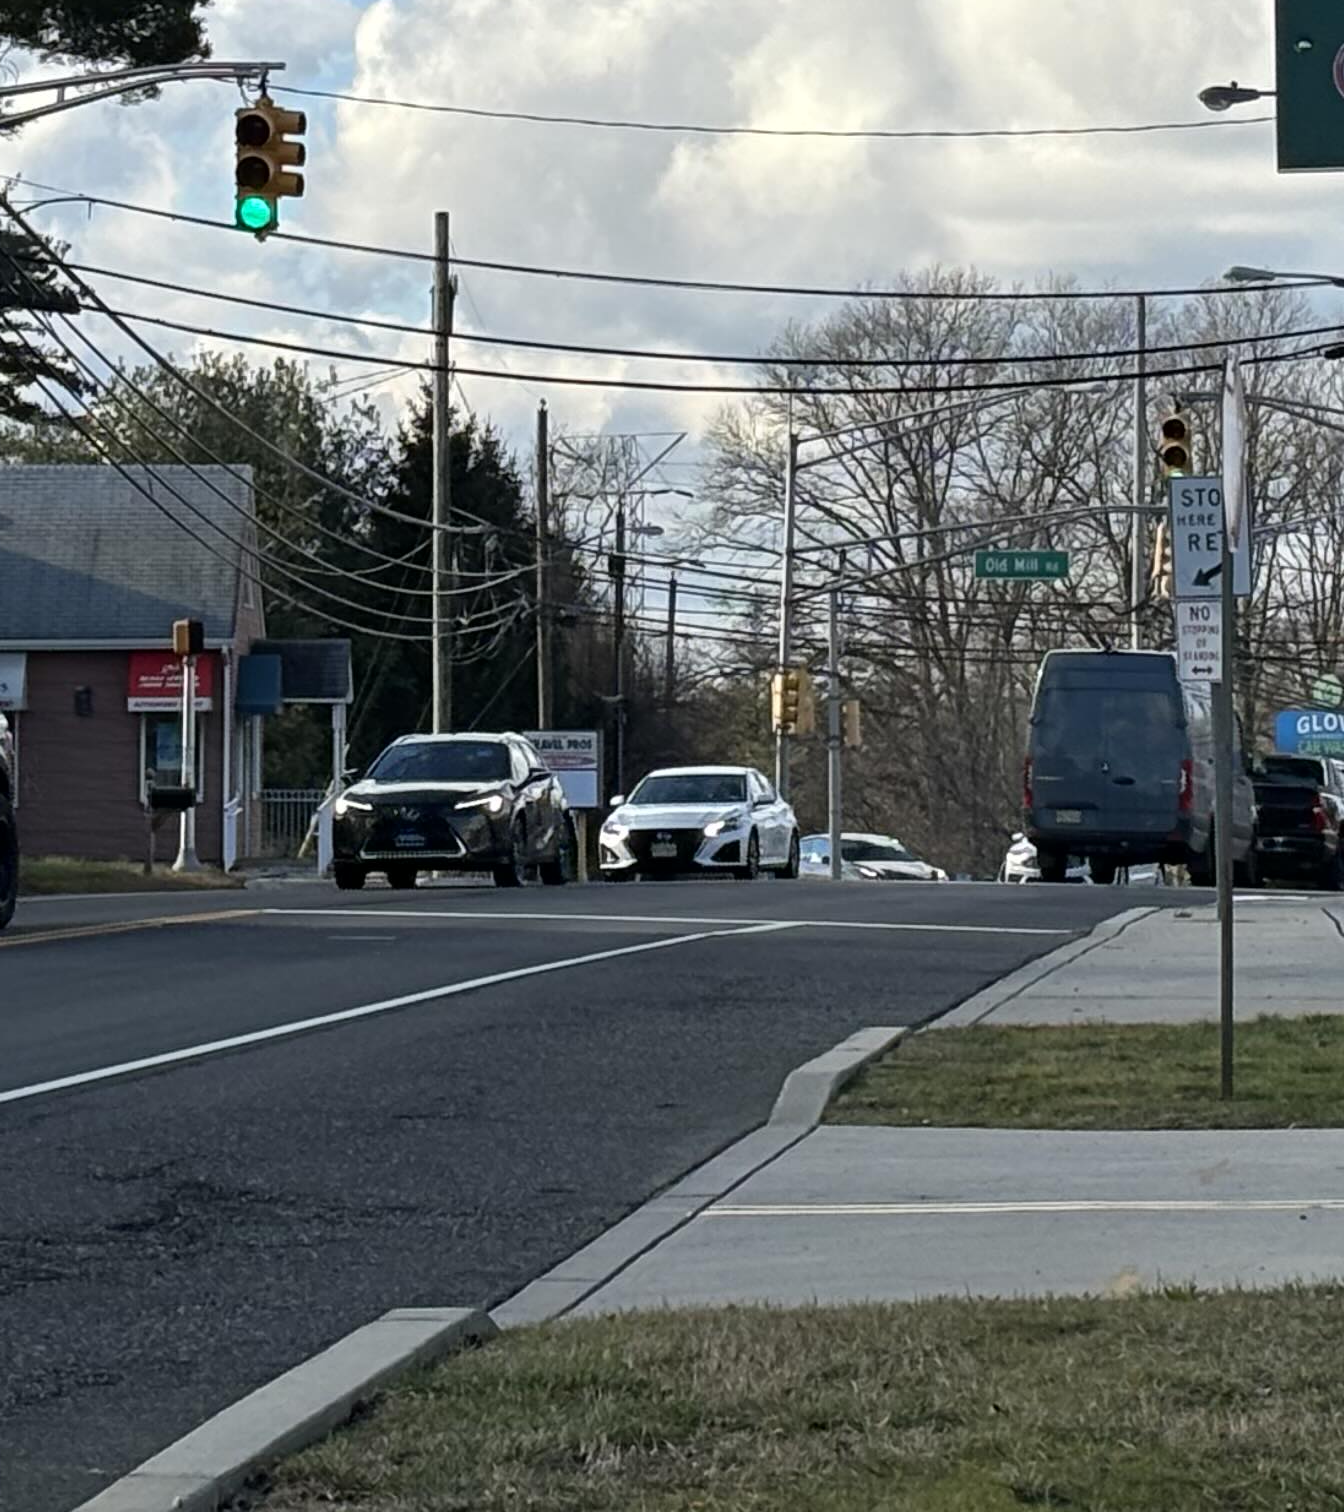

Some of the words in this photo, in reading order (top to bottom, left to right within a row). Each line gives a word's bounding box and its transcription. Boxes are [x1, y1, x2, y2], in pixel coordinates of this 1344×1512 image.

[1181, 489, 1221, 508] STO
[1177, 514, 1216, 526] HERE
[1188, 533, 1223, 553] RE
[985, 557, 1008, 573] Old
[1014, 557, 1038, 572] Mill
[1189, 606, 1211, 621] NO
